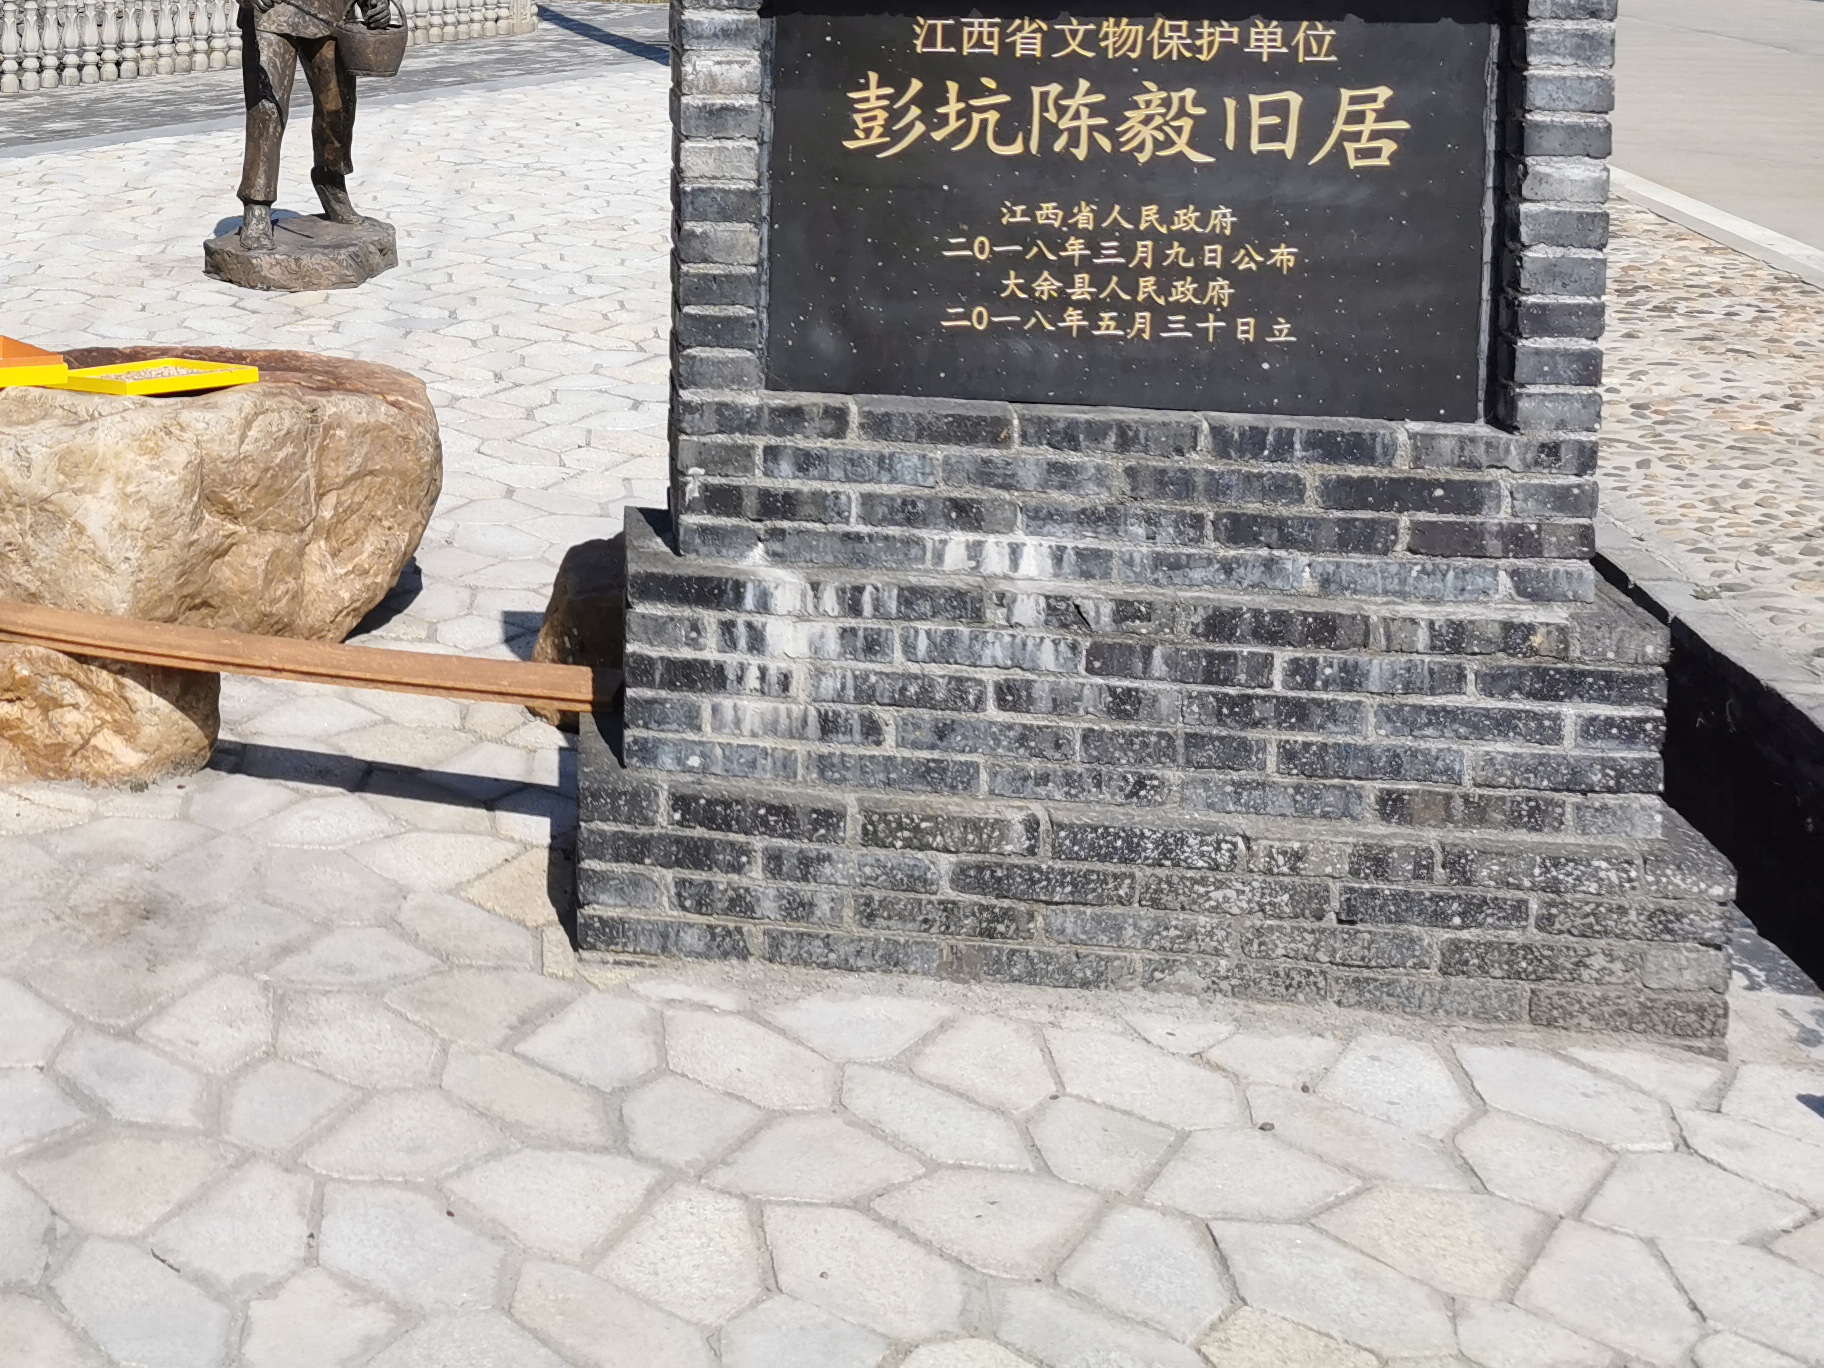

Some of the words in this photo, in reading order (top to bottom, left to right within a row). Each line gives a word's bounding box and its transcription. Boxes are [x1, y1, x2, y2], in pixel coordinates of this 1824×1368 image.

[912, 16, 1338, 62] 江西省文物保护单位
[842, 71, 1411, 169] 彭坑陈毅旧居
[1000, 200, 1238, 236] 江西省人民政府
[1000, 269, 1235, 307] 大余县人民政府
